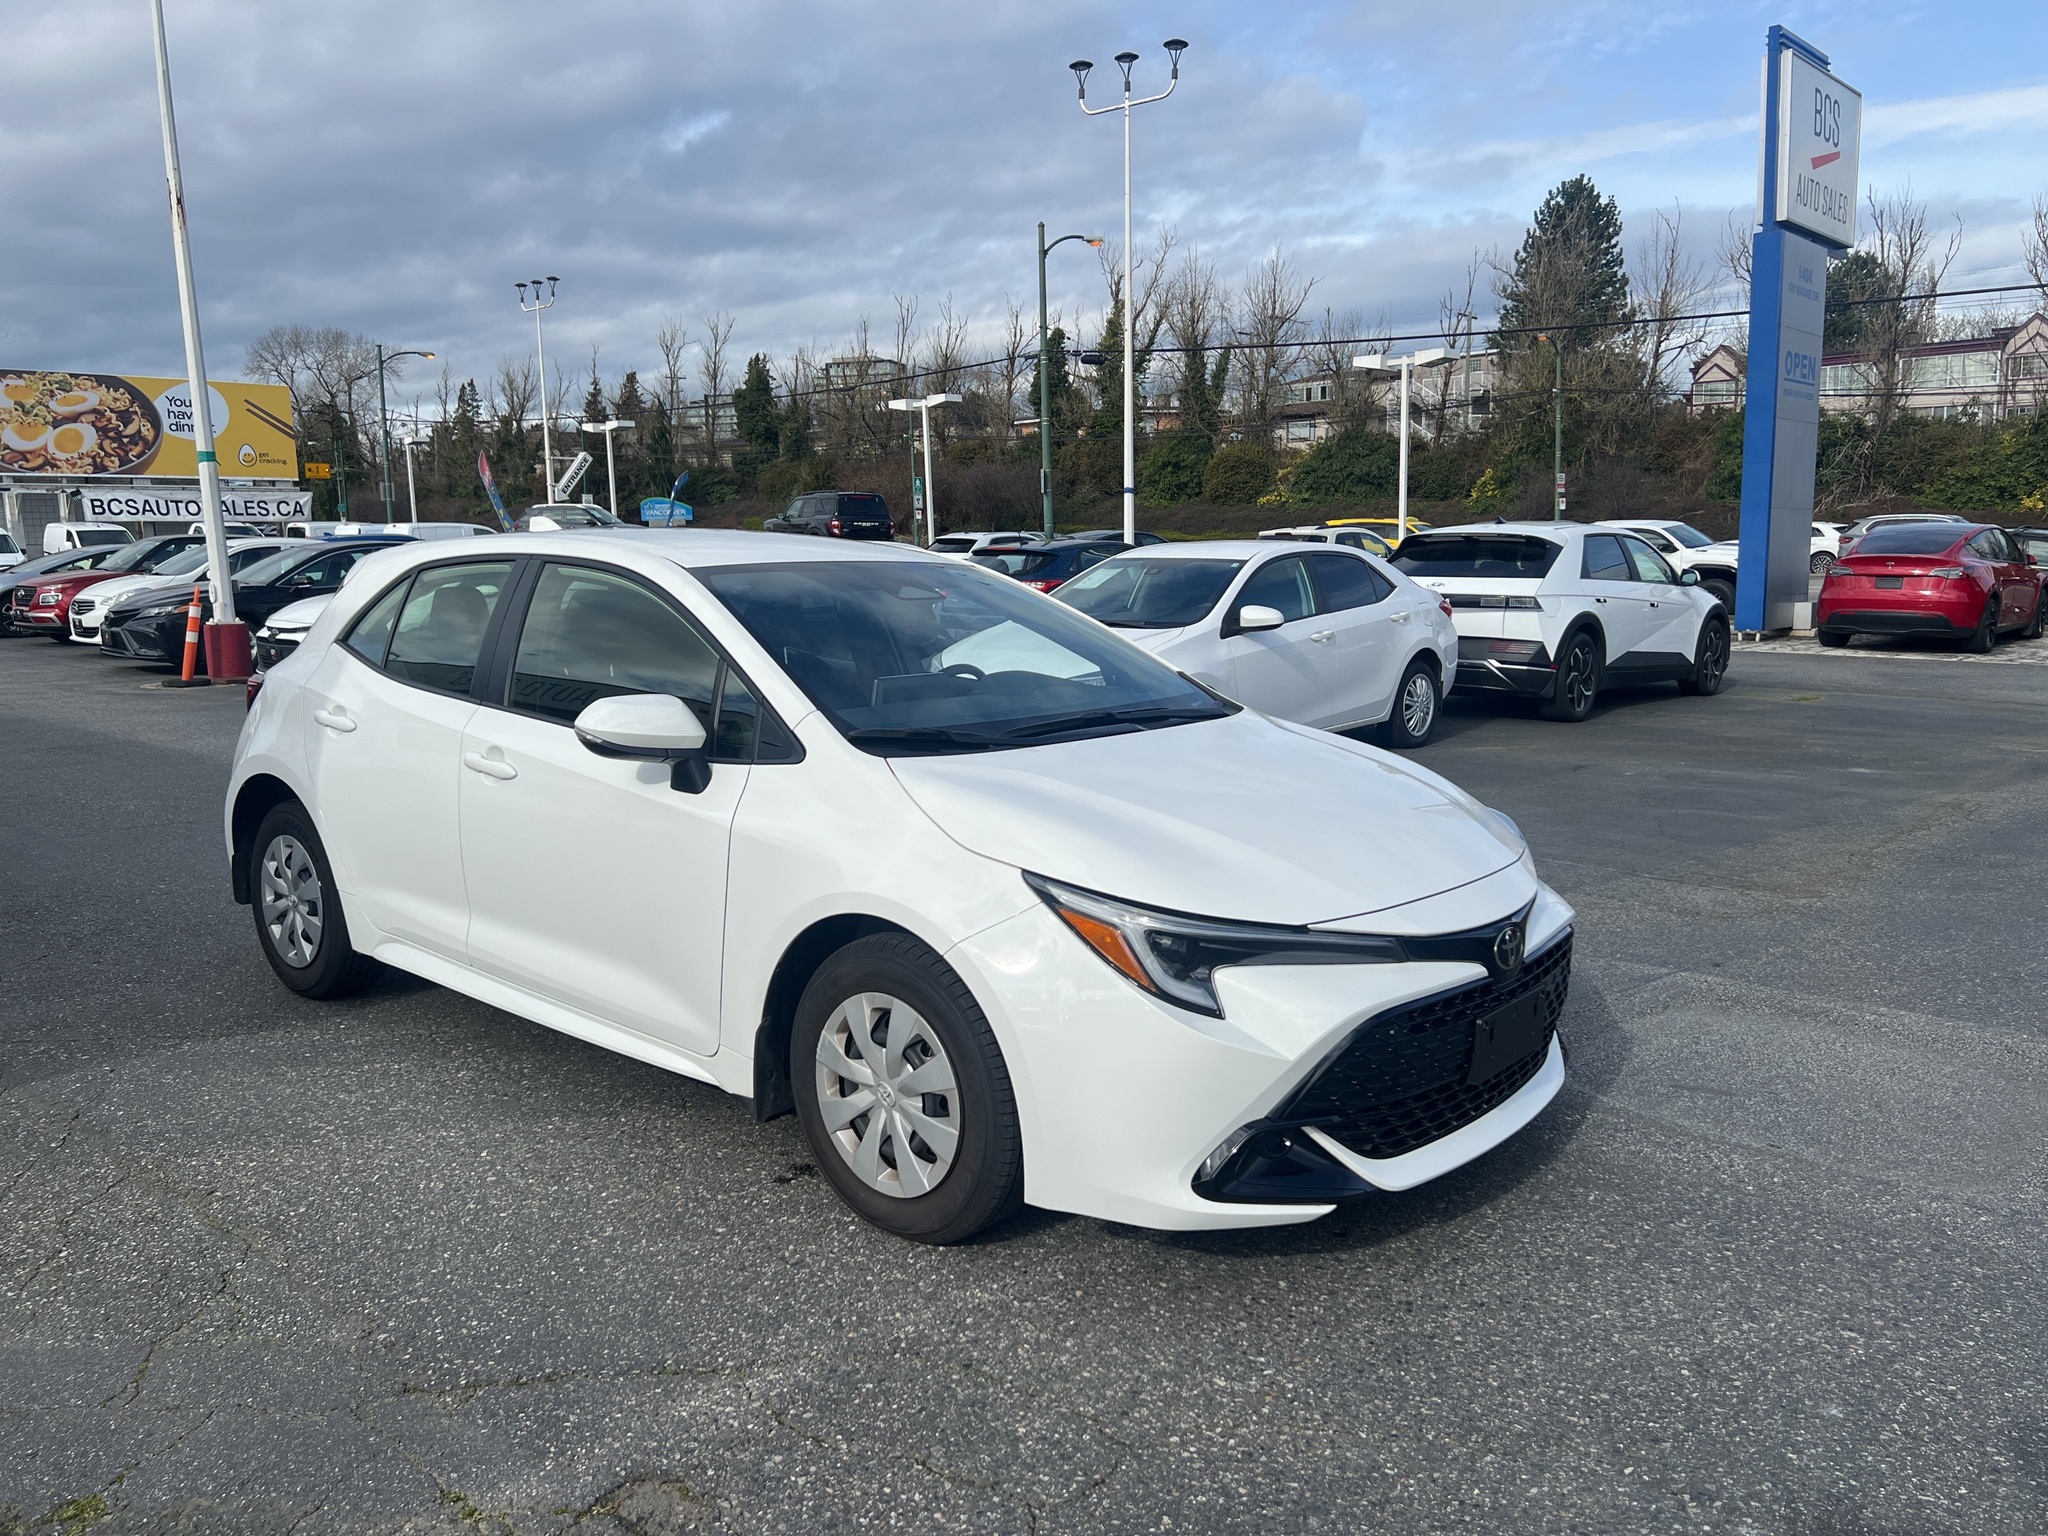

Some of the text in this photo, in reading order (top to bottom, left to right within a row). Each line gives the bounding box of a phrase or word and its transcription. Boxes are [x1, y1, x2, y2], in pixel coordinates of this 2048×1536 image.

[1813, 87, 1841, 148] BCS
[1796, 173, 1848, 225] AUTO SALES
[1785, 350, 1816, 381] OPEN
[167, 407, 193, 420] hav
[561, 457, 590, 494] ENTRANCE
[90, 498, 305, 518] BCSAUTOALES.CA
